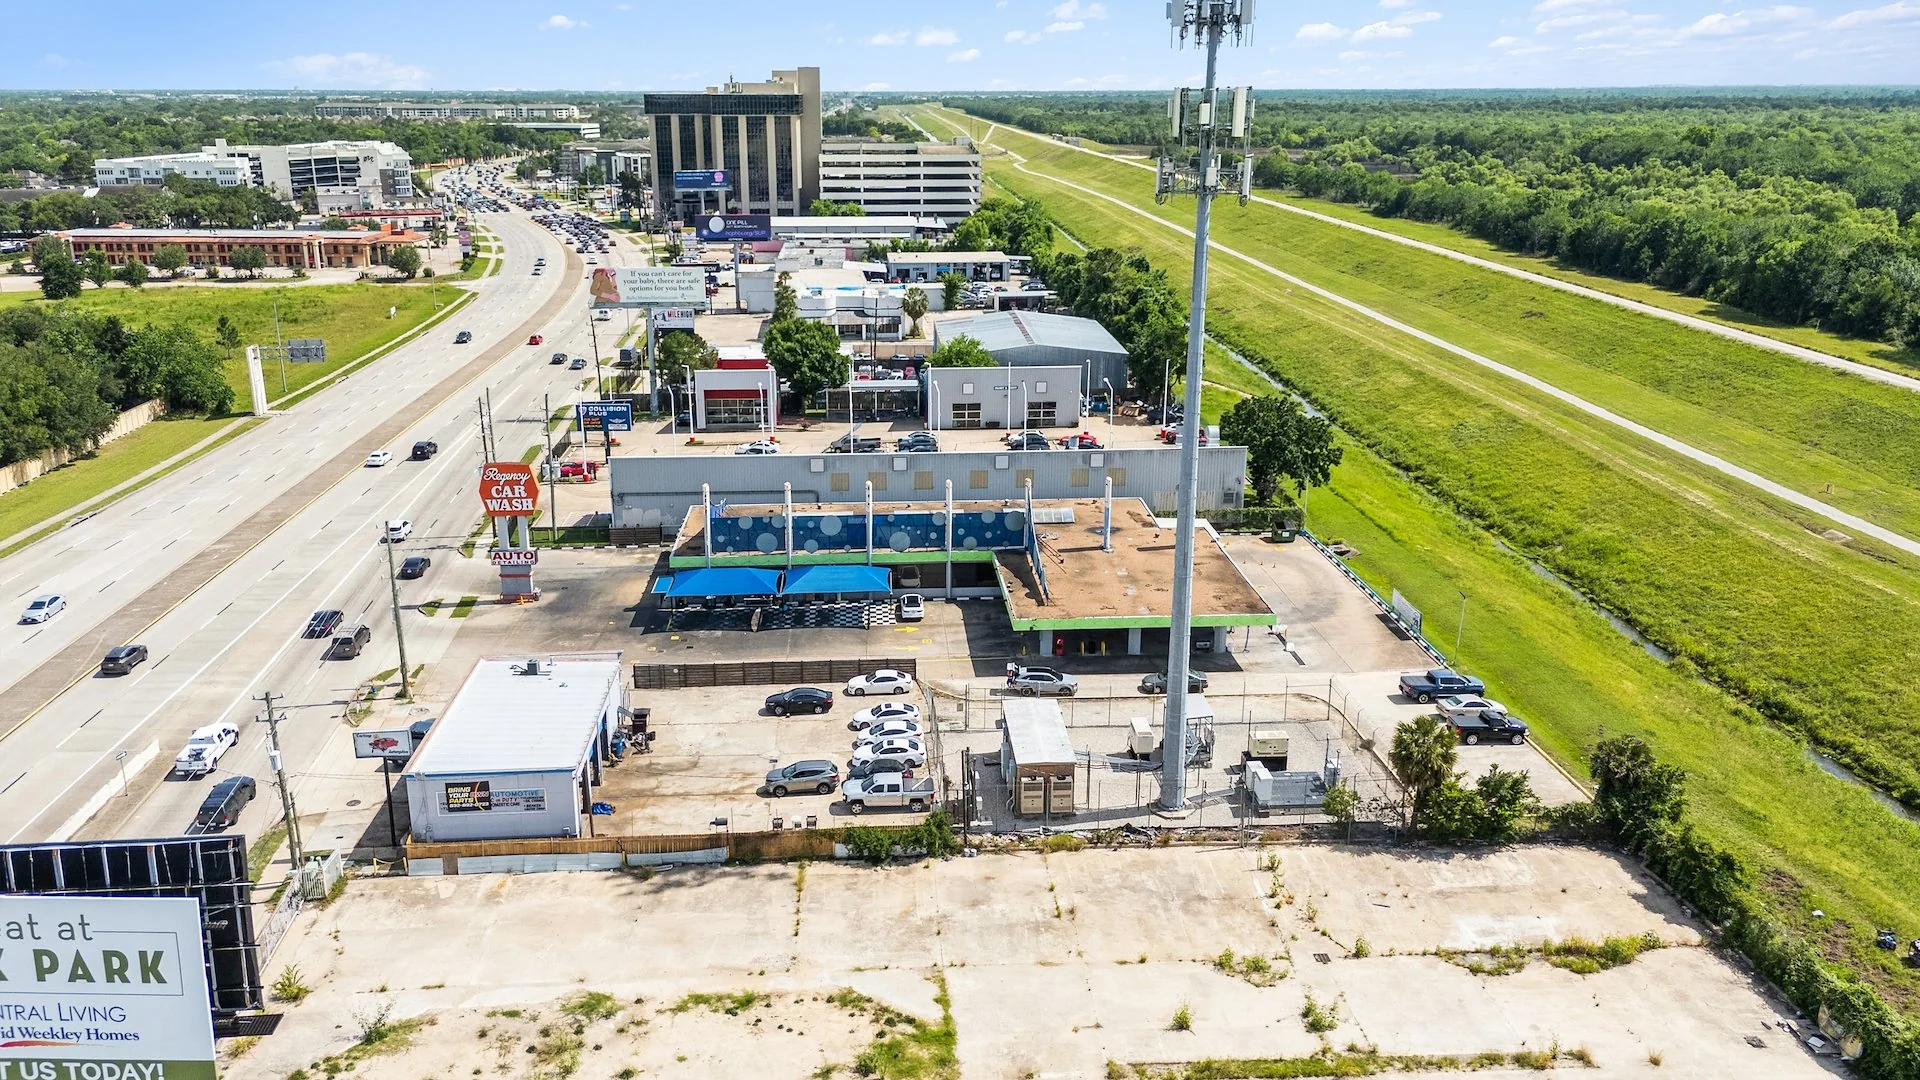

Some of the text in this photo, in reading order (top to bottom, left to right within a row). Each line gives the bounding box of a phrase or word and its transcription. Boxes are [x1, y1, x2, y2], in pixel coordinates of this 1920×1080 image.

[484, 468, 530, 485] Regency
[491, 486, 527, 498] CAR
[485, 499, 534, 511] WASH
[493, 552, 534, 560] AUTO
[0, 914, 93, 941] at at
[33, 949, 167, 984] PARK
[58, 1003, 126, 1022] LIVING
[18, 1027, 82, 1042] Weekley
[86, 1028, 140, 1040] Homes
[20, 1062, 56, 1080] US
[62, 1063, 164, 1080] TODAY!
